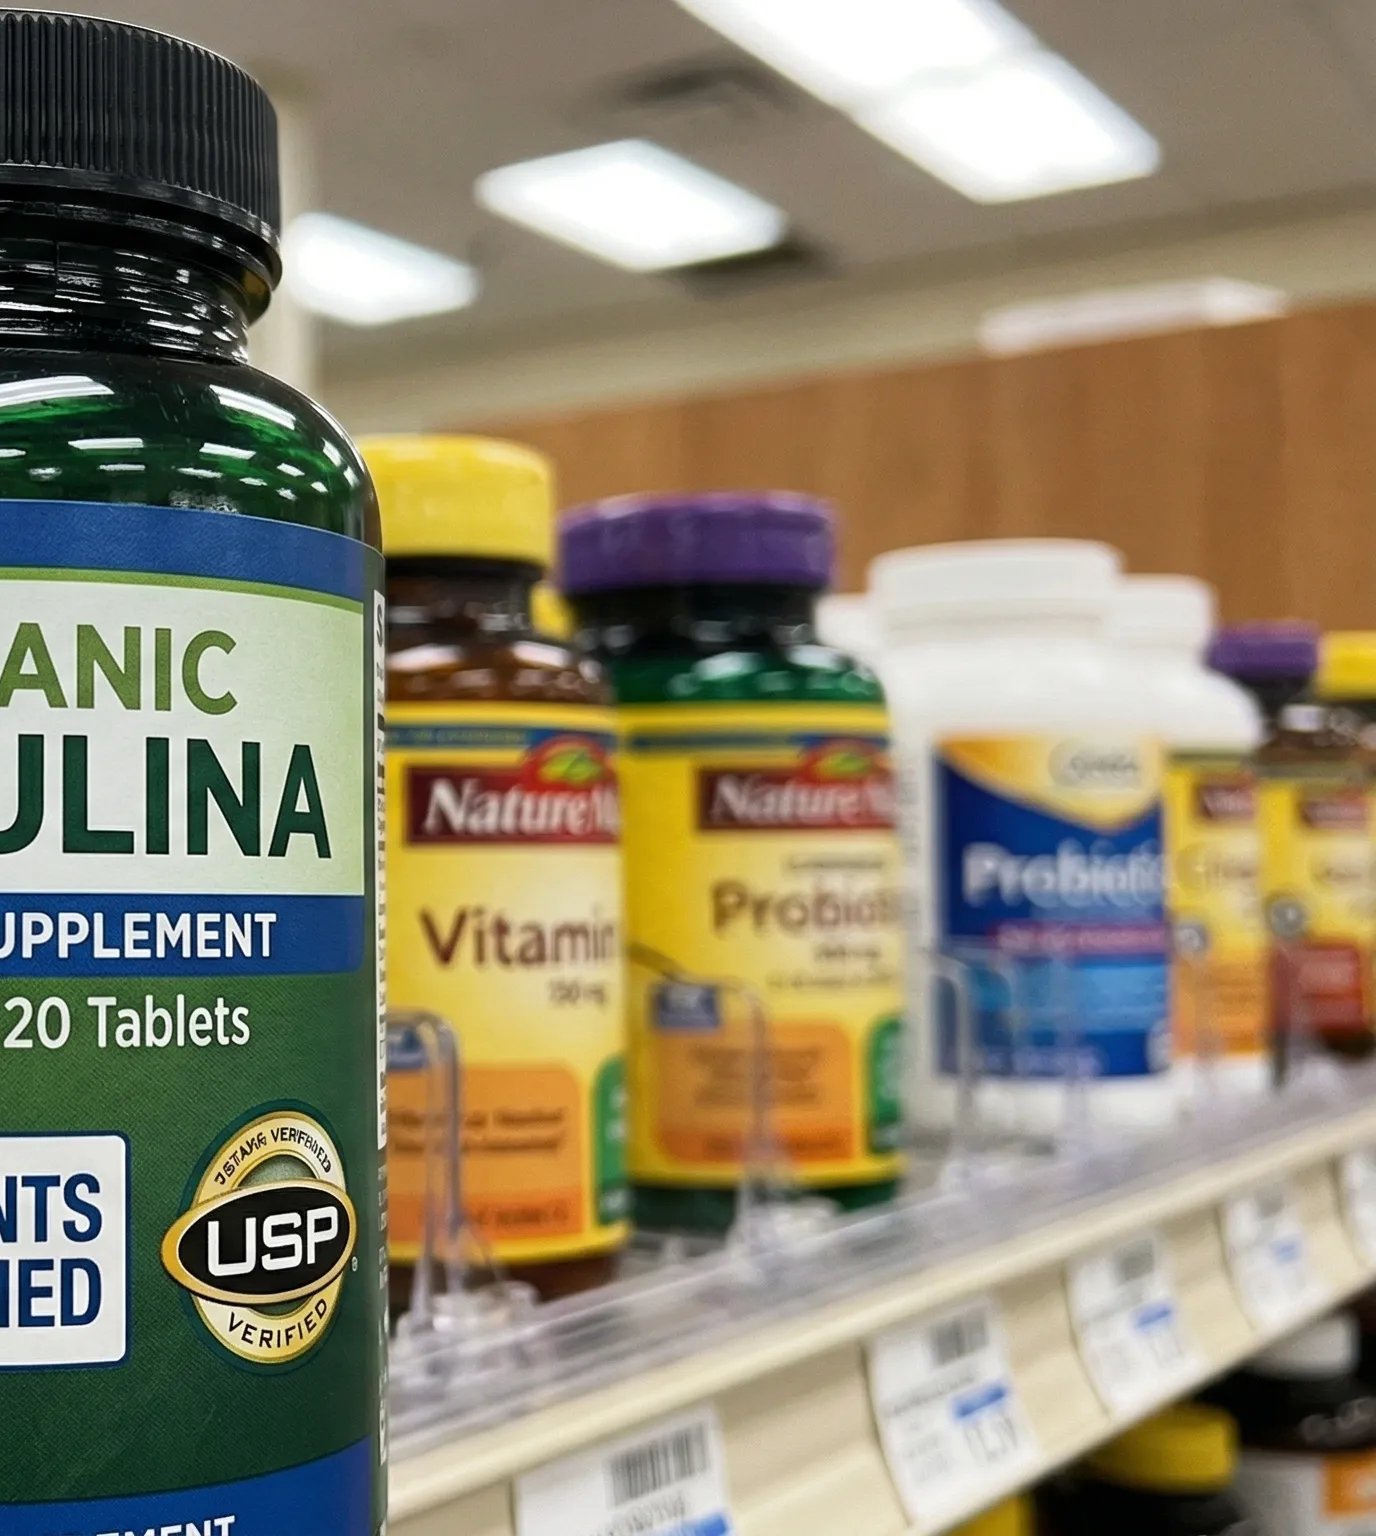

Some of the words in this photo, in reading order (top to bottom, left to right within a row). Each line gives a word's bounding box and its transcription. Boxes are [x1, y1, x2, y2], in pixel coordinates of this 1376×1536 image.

[87, 995, 252, 1049] Tablets
[206, 1205, 339, 1277] USP
[227, 1298, 328, 1349] VERIFIED
